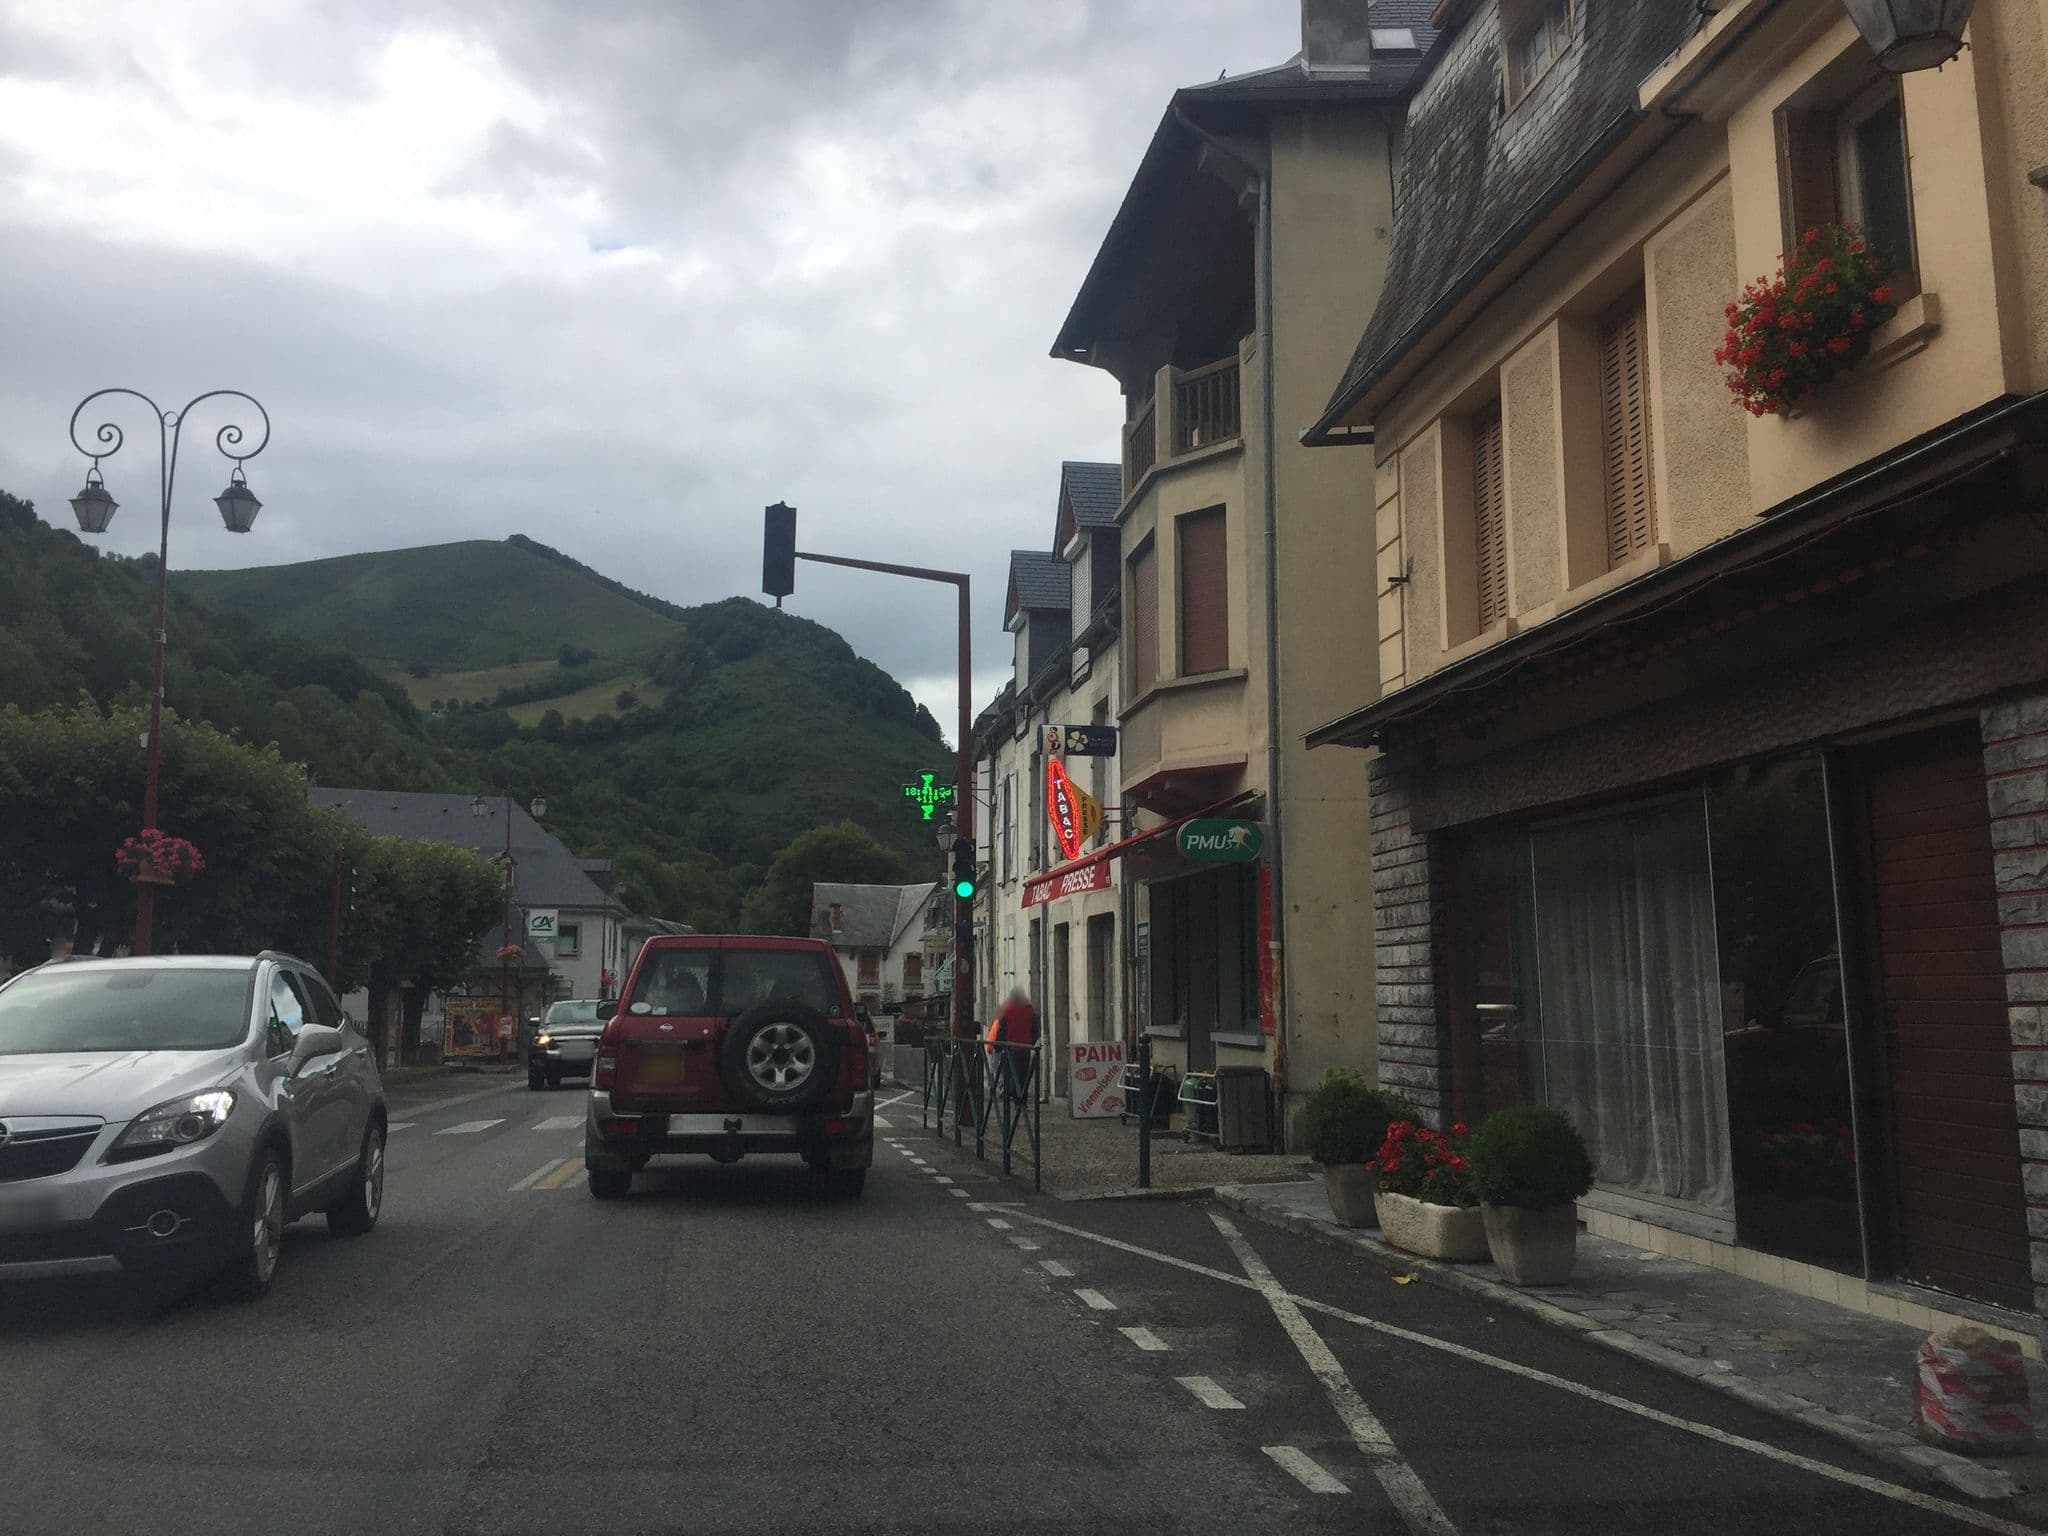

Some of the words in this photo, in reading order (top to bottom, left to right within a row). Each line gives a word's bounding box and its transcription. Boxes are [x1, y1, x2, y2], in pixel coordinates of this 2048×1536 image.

[1053, 779, 1073, 839] TABAC
[1187, 835, 1227, 850] PMU
[1031, 880, 1053, 904] TABAC
[1060, 865, 1096, 893] PRESSE
[1075, 1044, 1122, 1063] PAIN
[1078, 1065, 1120, 1113] Viennoiserie
